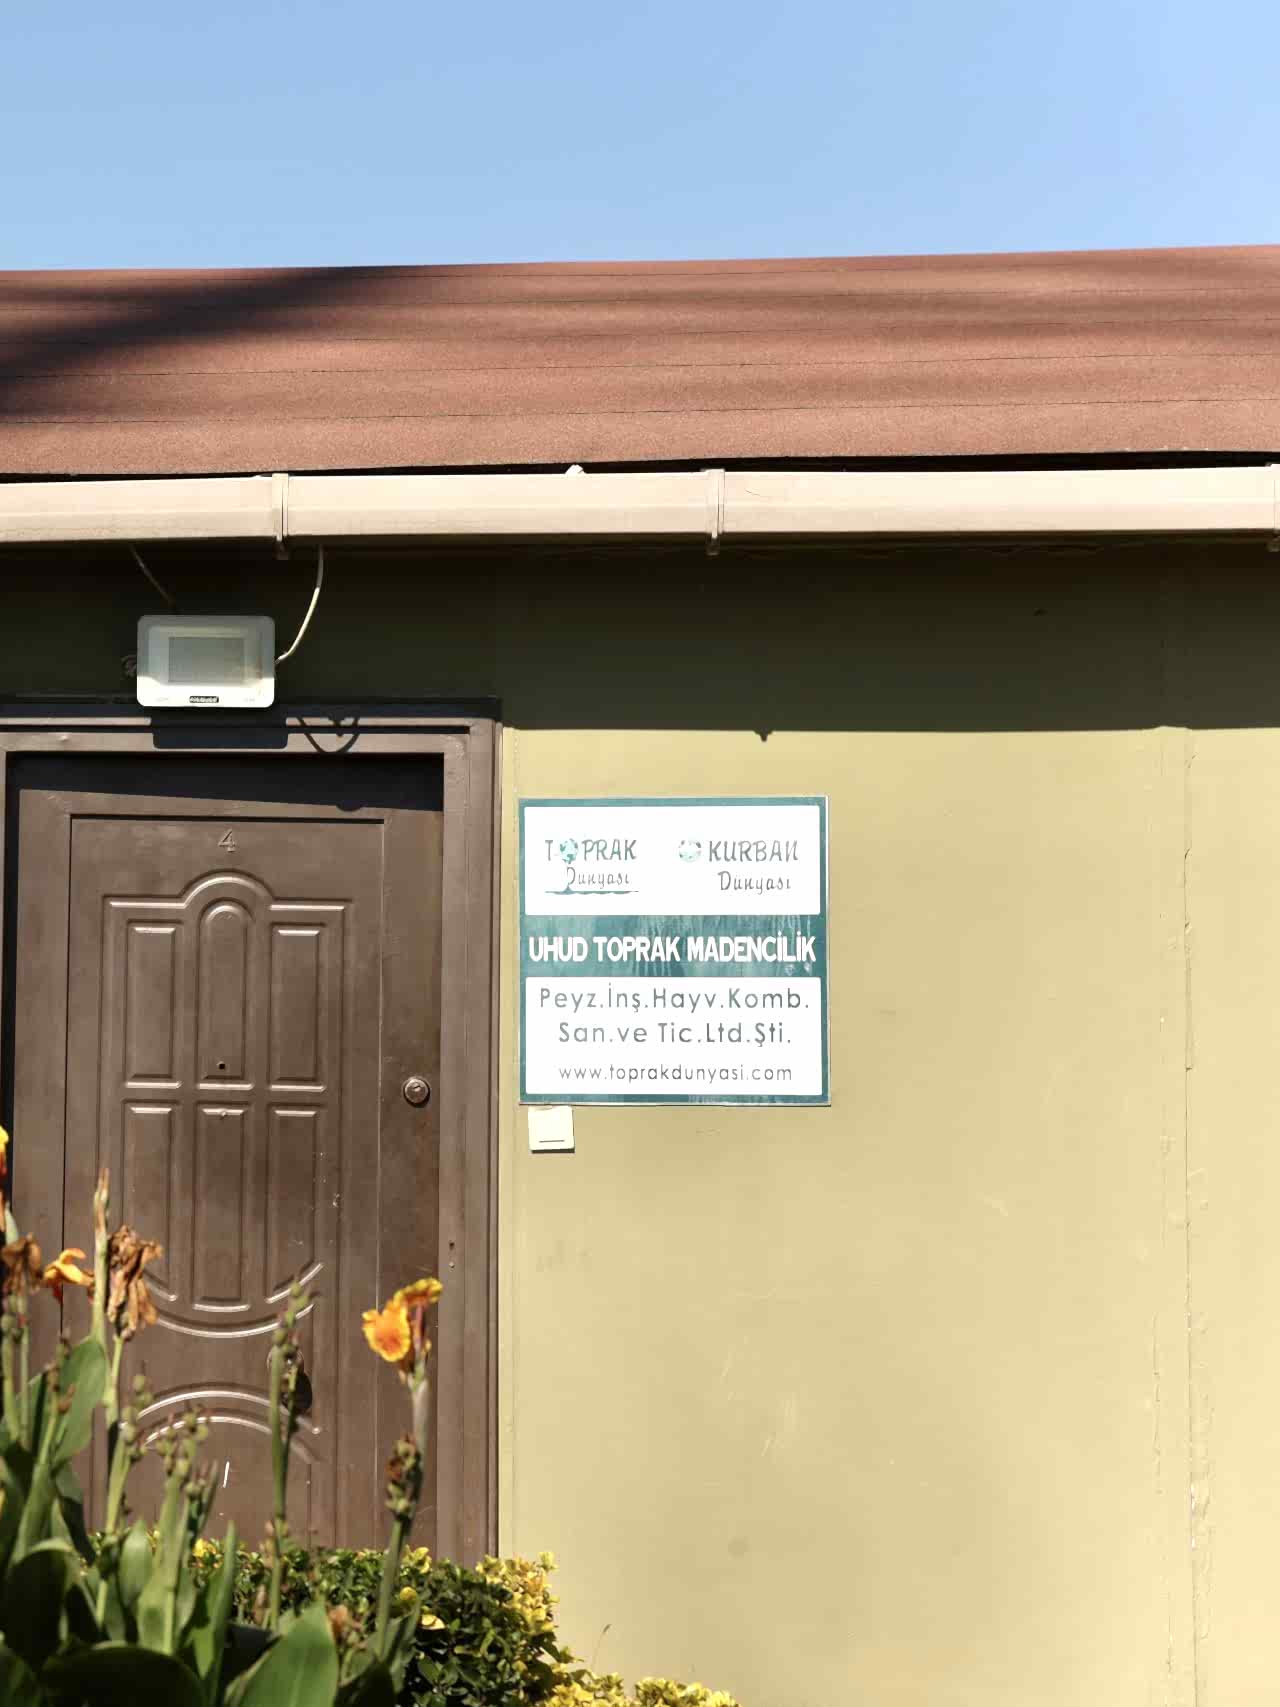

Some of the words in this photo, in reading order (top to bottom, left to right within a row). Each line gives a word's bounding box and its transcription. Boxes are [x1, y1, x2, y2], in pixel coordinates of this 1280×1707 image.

[708, 839, 799, 862] KURBAN
[528, 936, 588, 962] UHUD
[593, 936, 681, 962] TOPRAK
[687, 930, 817, 962] MADENCİLİK
[558, 1022, 648, 1043] San.ve
[559, 1064, 793, 1084] www.toprakdunyasi.com
